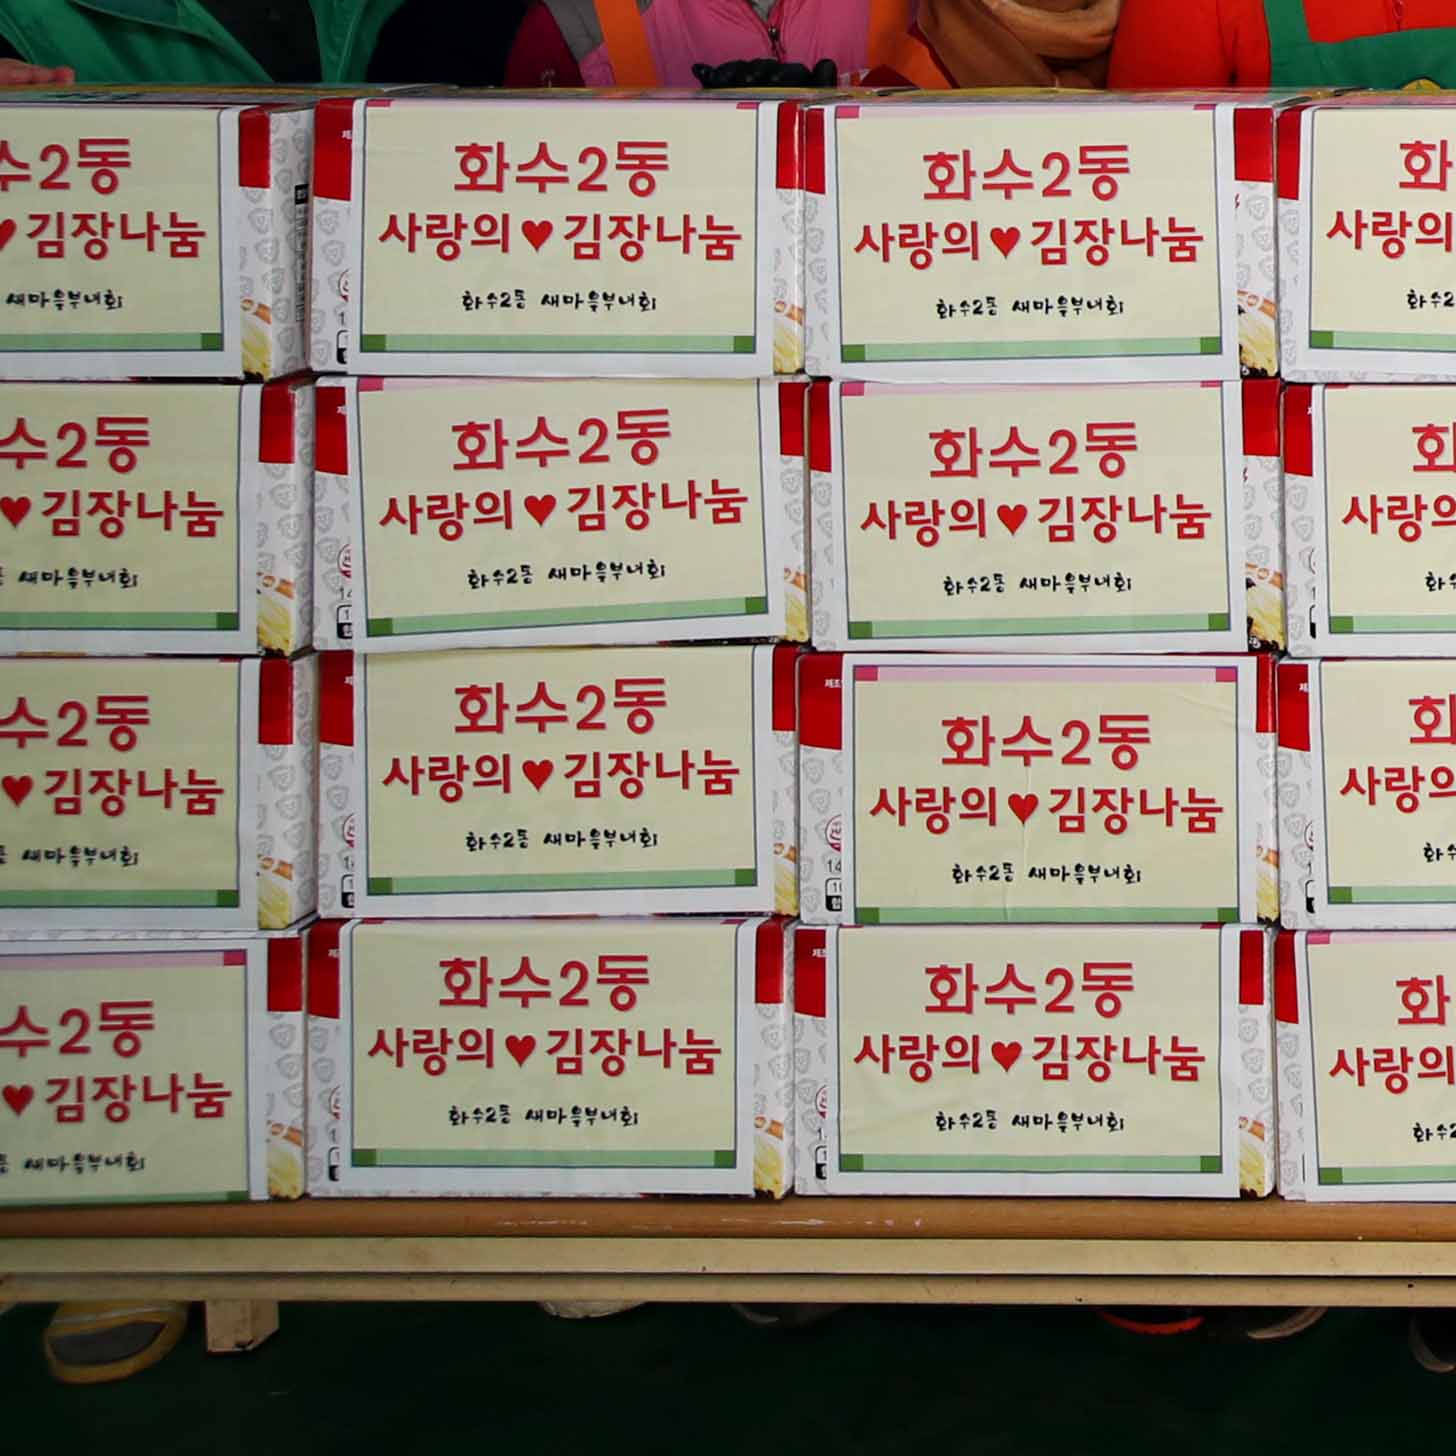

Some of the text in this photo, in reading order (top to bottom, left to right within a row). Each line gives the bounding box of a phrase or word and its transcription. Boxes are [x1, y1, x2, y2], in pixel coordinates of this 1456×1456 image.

[453, 139, 670, 199] 화수2동
[921, 143, 1131, 203] 화수2동
[30, 210, 207, 262] 김장나눔
[460, 287, 527, 313] 화수2동
[451, 407, 673, 472] 화수2동
[928, 420, 1138, 480] 화수2동
[42, 489, 225, 540] 김장나눔
[942, 571, 1006, 598] 화수2동
[453, 676, 668, 736] 화수2동
[941, 713, 1154, 772] 화수2동
[46, 767, 226, 818] 김장나눔
[438, 953, 651, 1013] 화수2동
[925, 960, 1137, 1021] 화수2동
[48, 1072, 232, 1123] 김장나눔
[447, 1102, 512, 1128] 화수2동
